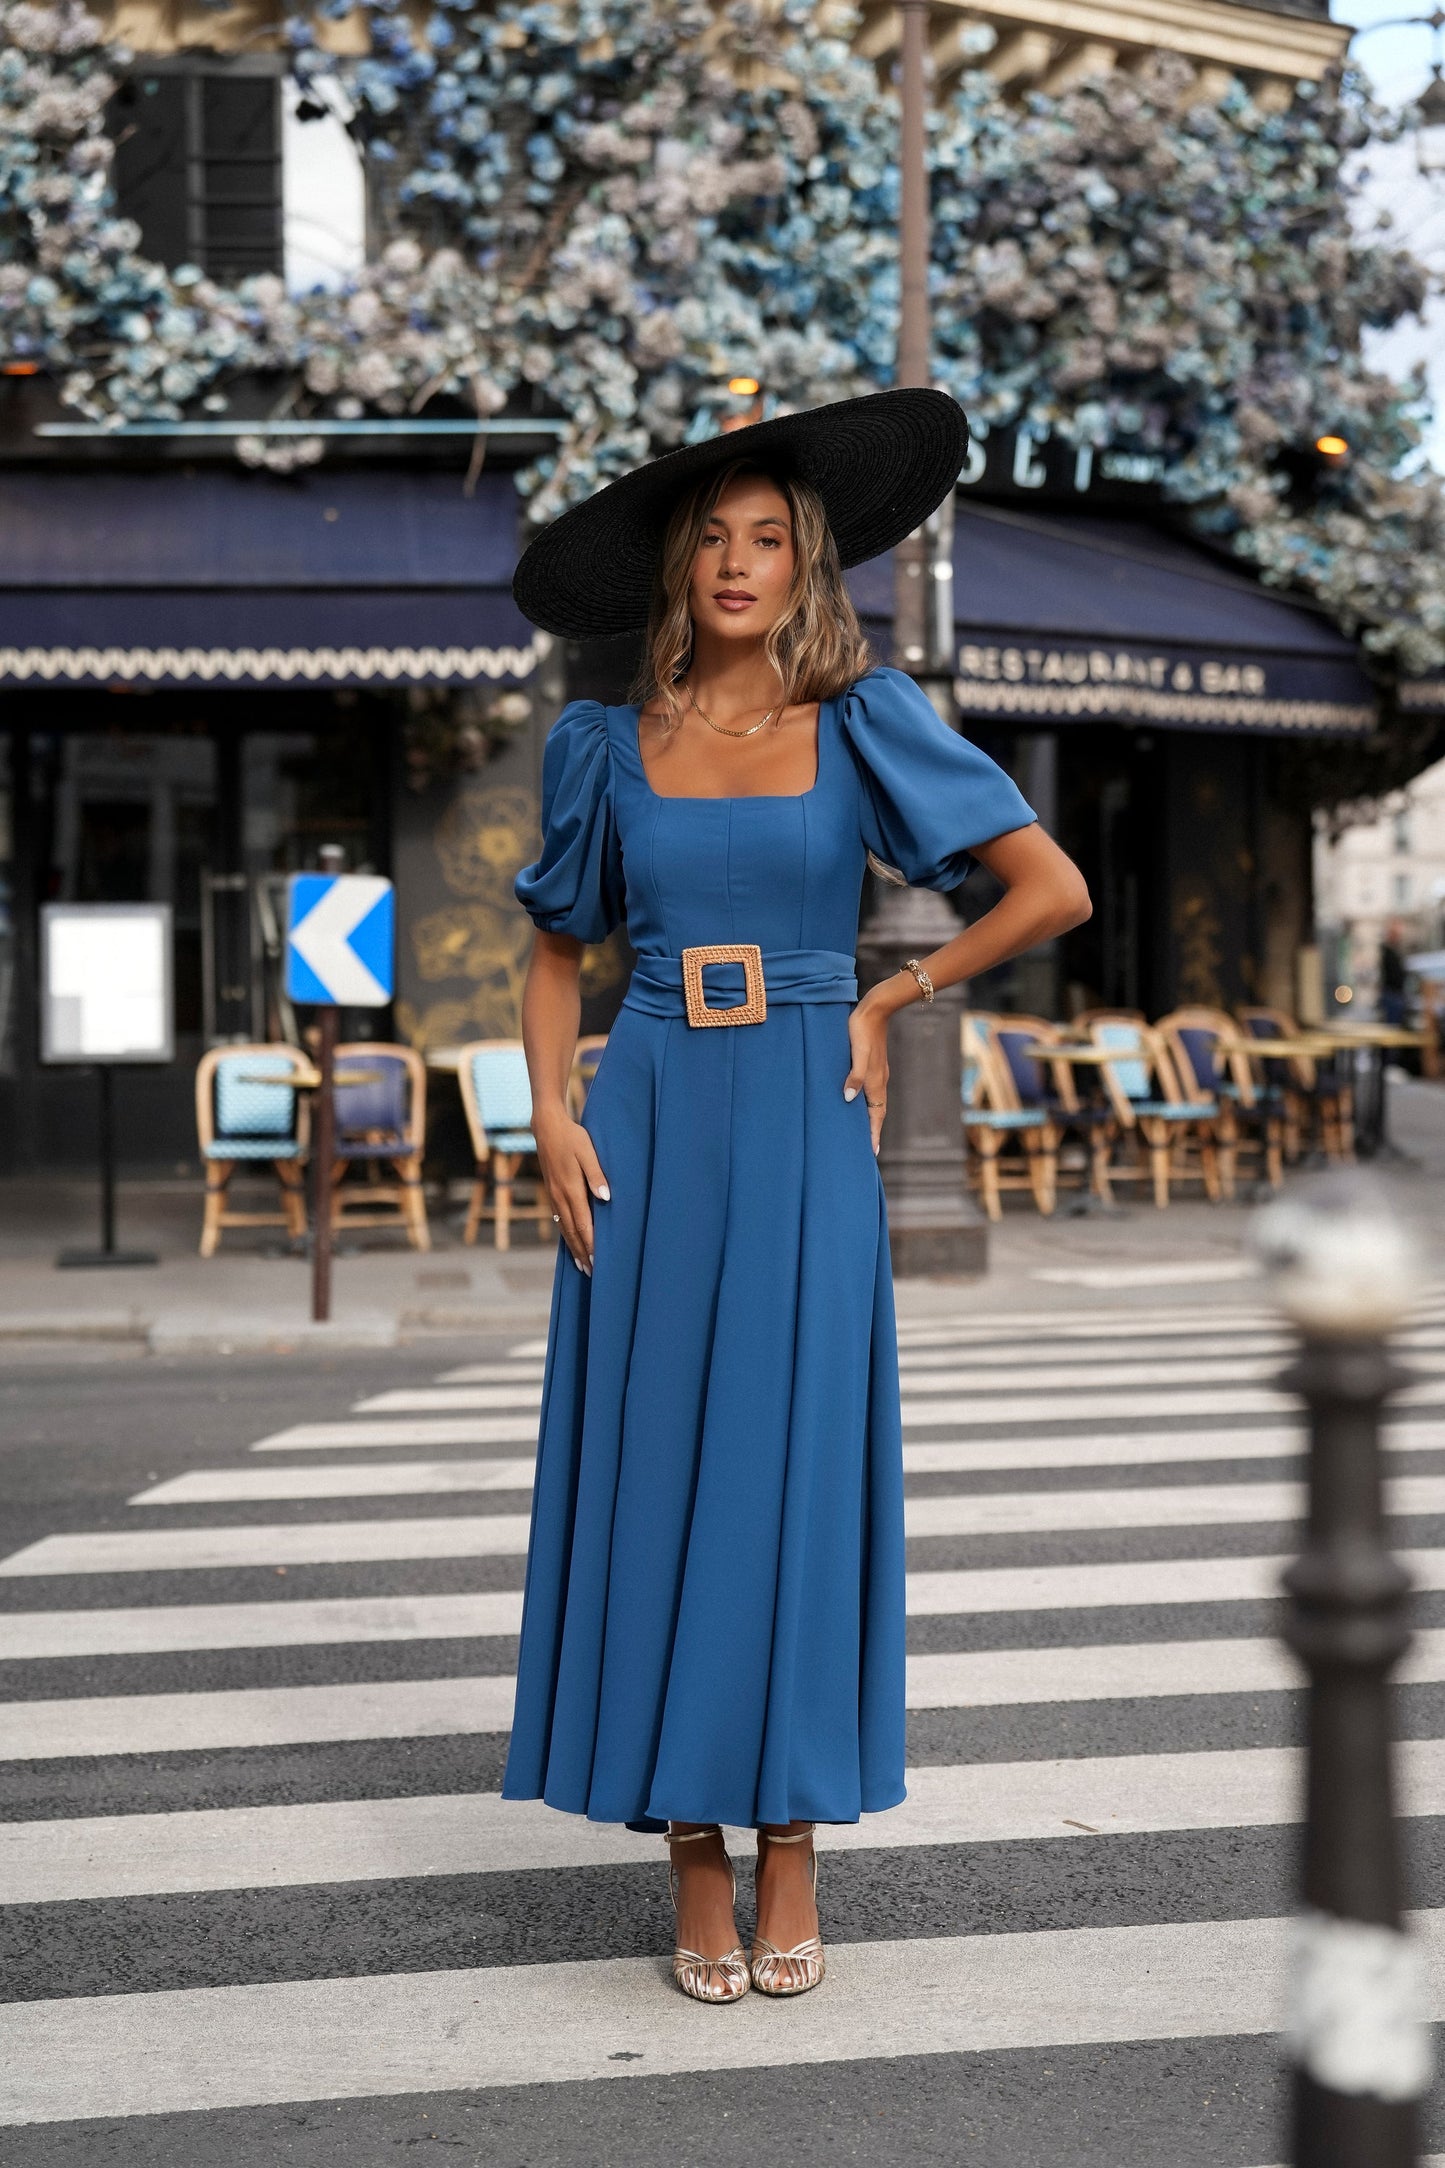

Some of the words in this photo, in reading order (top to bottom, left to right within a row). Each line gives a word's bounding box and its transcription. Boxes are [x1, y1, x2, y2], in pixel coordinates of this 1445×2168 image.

[959, 645, 1168, 689] RESTAURANT
[1171, 661, 1194, 692] &
[1200, 661, 1266, 695] BAR
